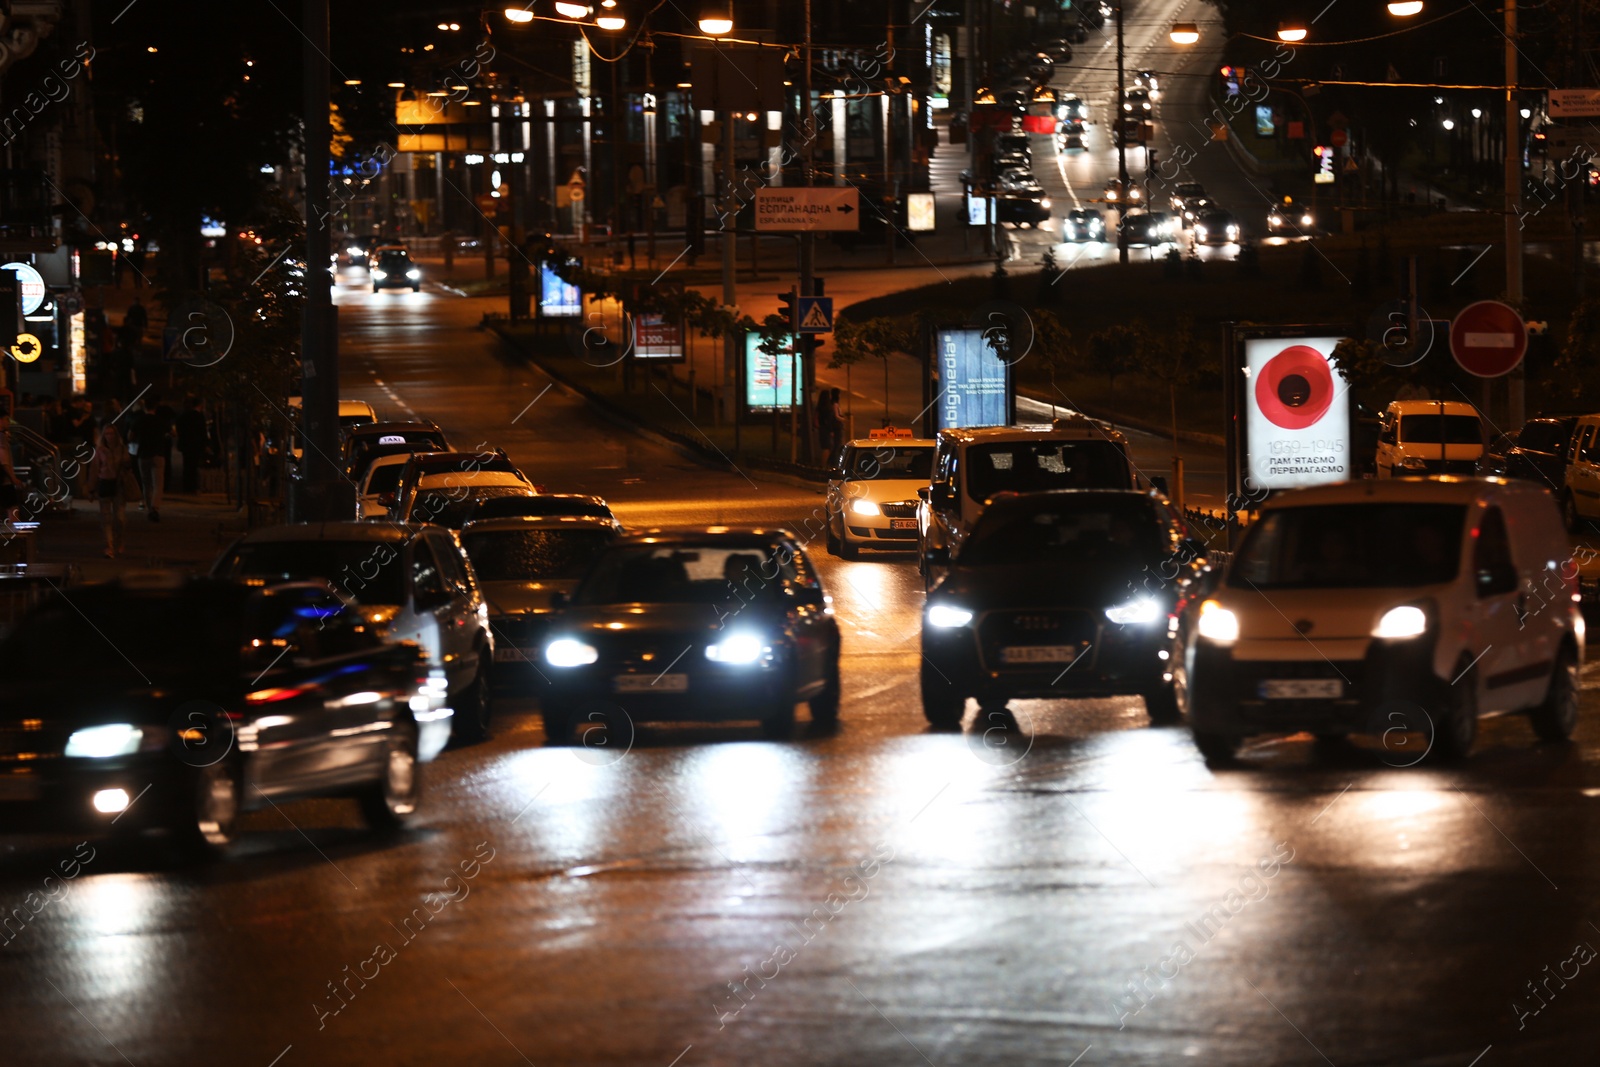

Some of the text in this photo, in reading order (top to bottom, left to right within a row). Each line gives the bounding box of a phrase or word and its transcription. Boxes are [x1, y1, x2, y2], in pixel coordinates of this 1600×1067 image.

[759, 204, 832, 215] ЕСПЛАНАДНА
[945, 343, 962, 421] bigmedia
[1270, 465, 1344, 475] ПЕРЕМАГАЄМО
